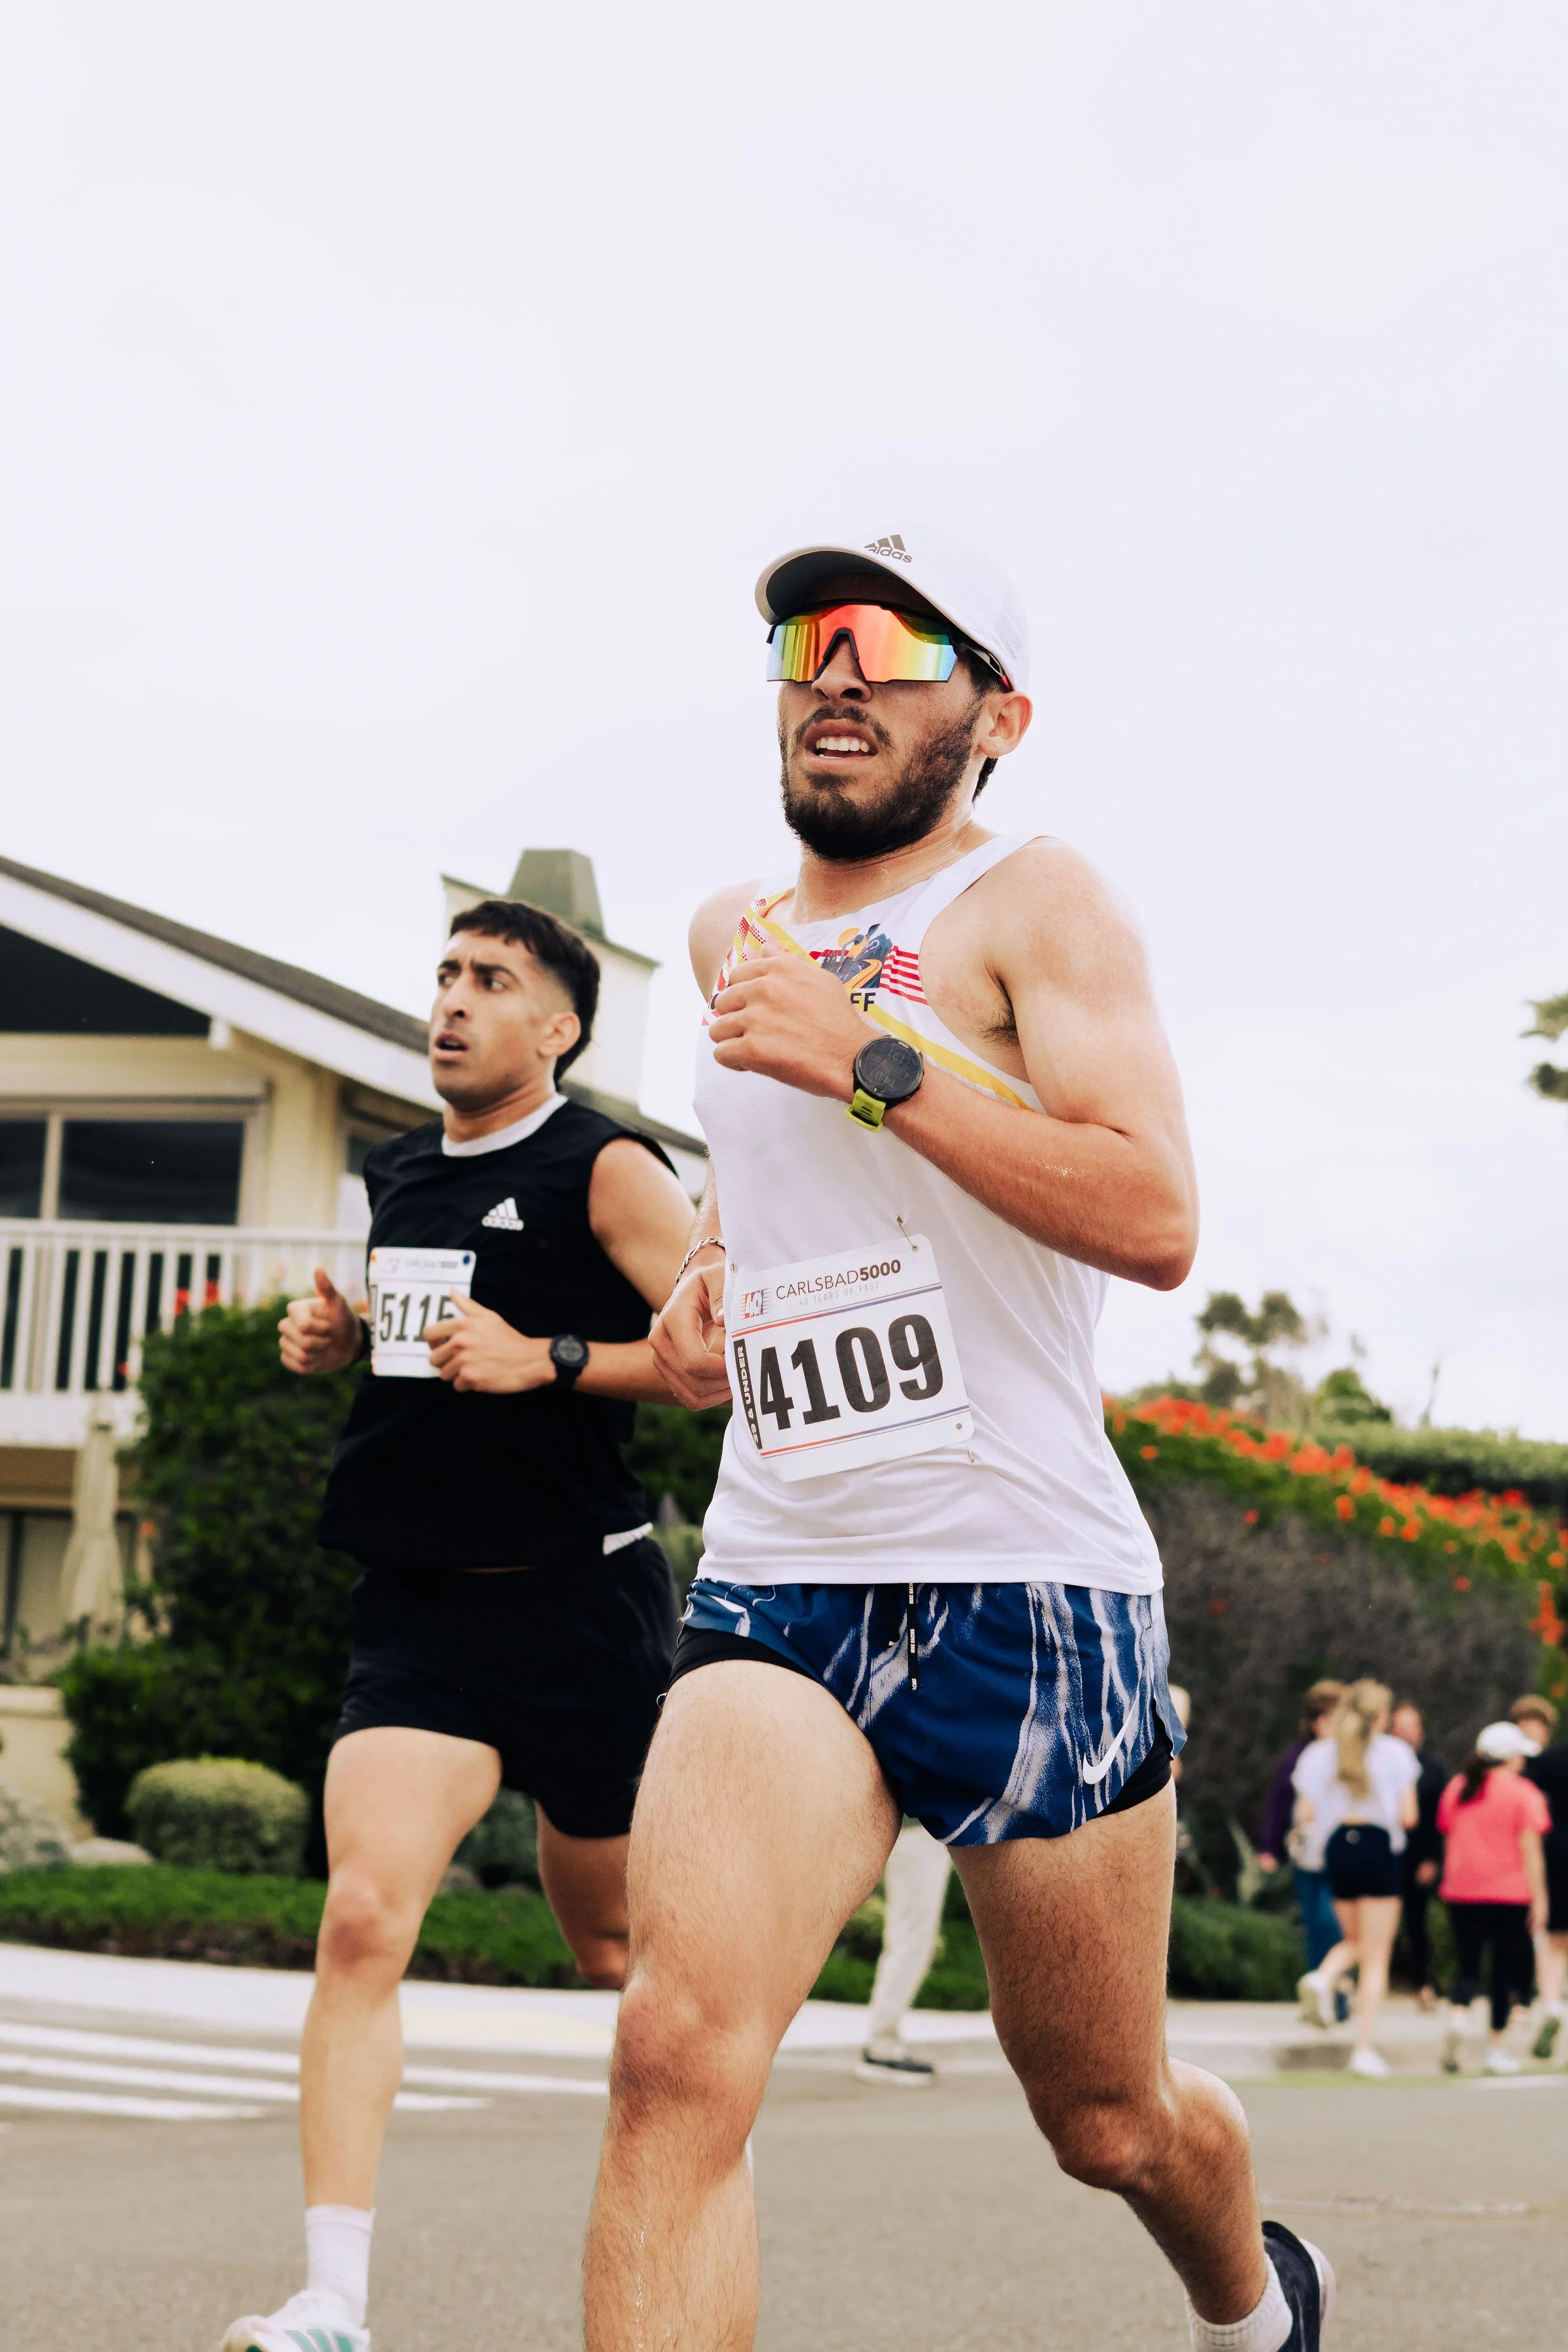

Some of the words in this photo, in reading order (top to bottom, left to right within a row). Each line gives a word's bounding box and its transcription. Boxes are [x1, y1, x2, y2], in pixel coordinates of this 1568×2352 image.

[868, 546, 913, 563] adidas
[776, 1259, 902, 1300] CARLSBAD5000
[813, 1291, 839, 1304] YEARS
[843, 1287, 854, 1298] OF
[737, 1345, 751, 1405] UNDER
[759, 1314, 944, 1431] 4109
[747, 1408, 754, 1420] &
